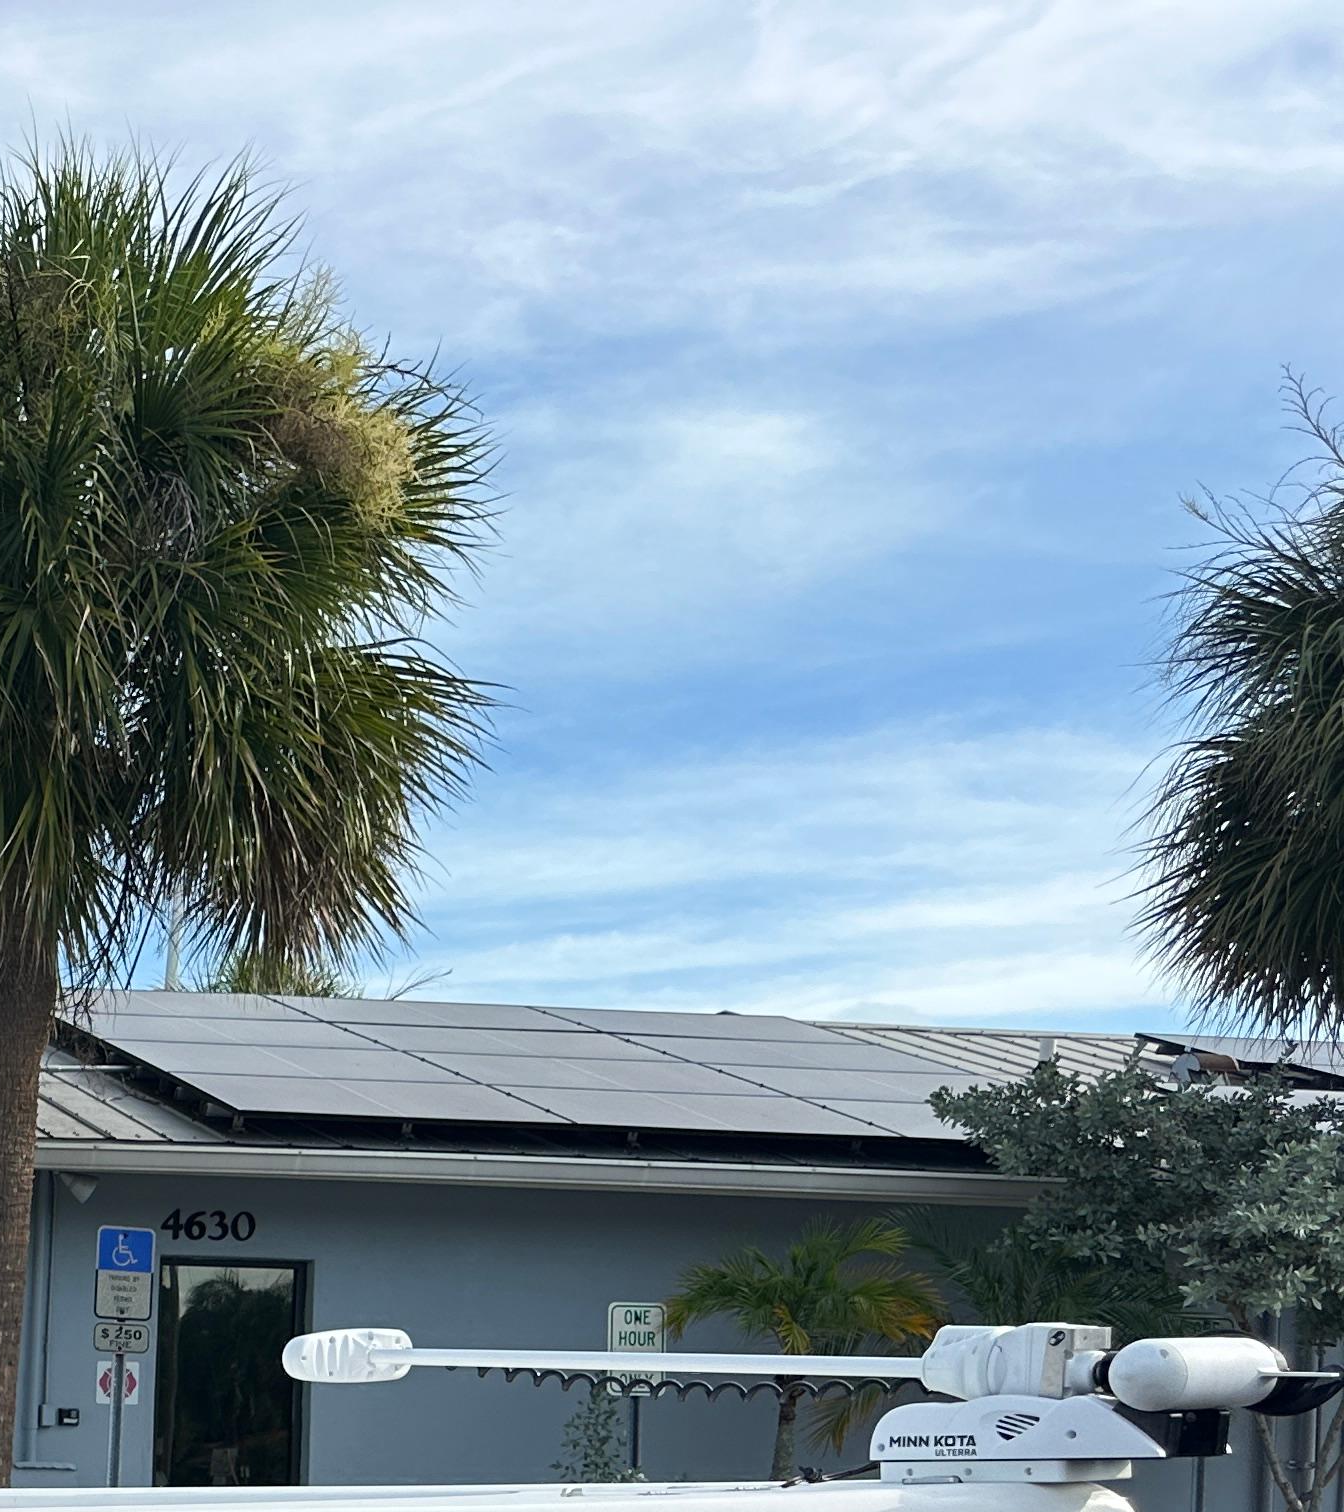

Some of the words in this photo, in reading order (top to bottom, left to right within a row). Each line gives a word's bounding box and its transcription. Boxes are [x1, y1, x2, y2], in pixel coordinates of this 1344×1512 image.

[160, 1208, 256, 1241] 4630
[623, 1309, 652, 1326] ONE
[114, 1328, 143, 1341] 250
[618, 1331, 656, 1346] HOUR
[889, 1435, 930, 1448] MINN
[933, 1434, 977, 1447] KOTA
[934, 1448, 978, 1457] ULTERRA
